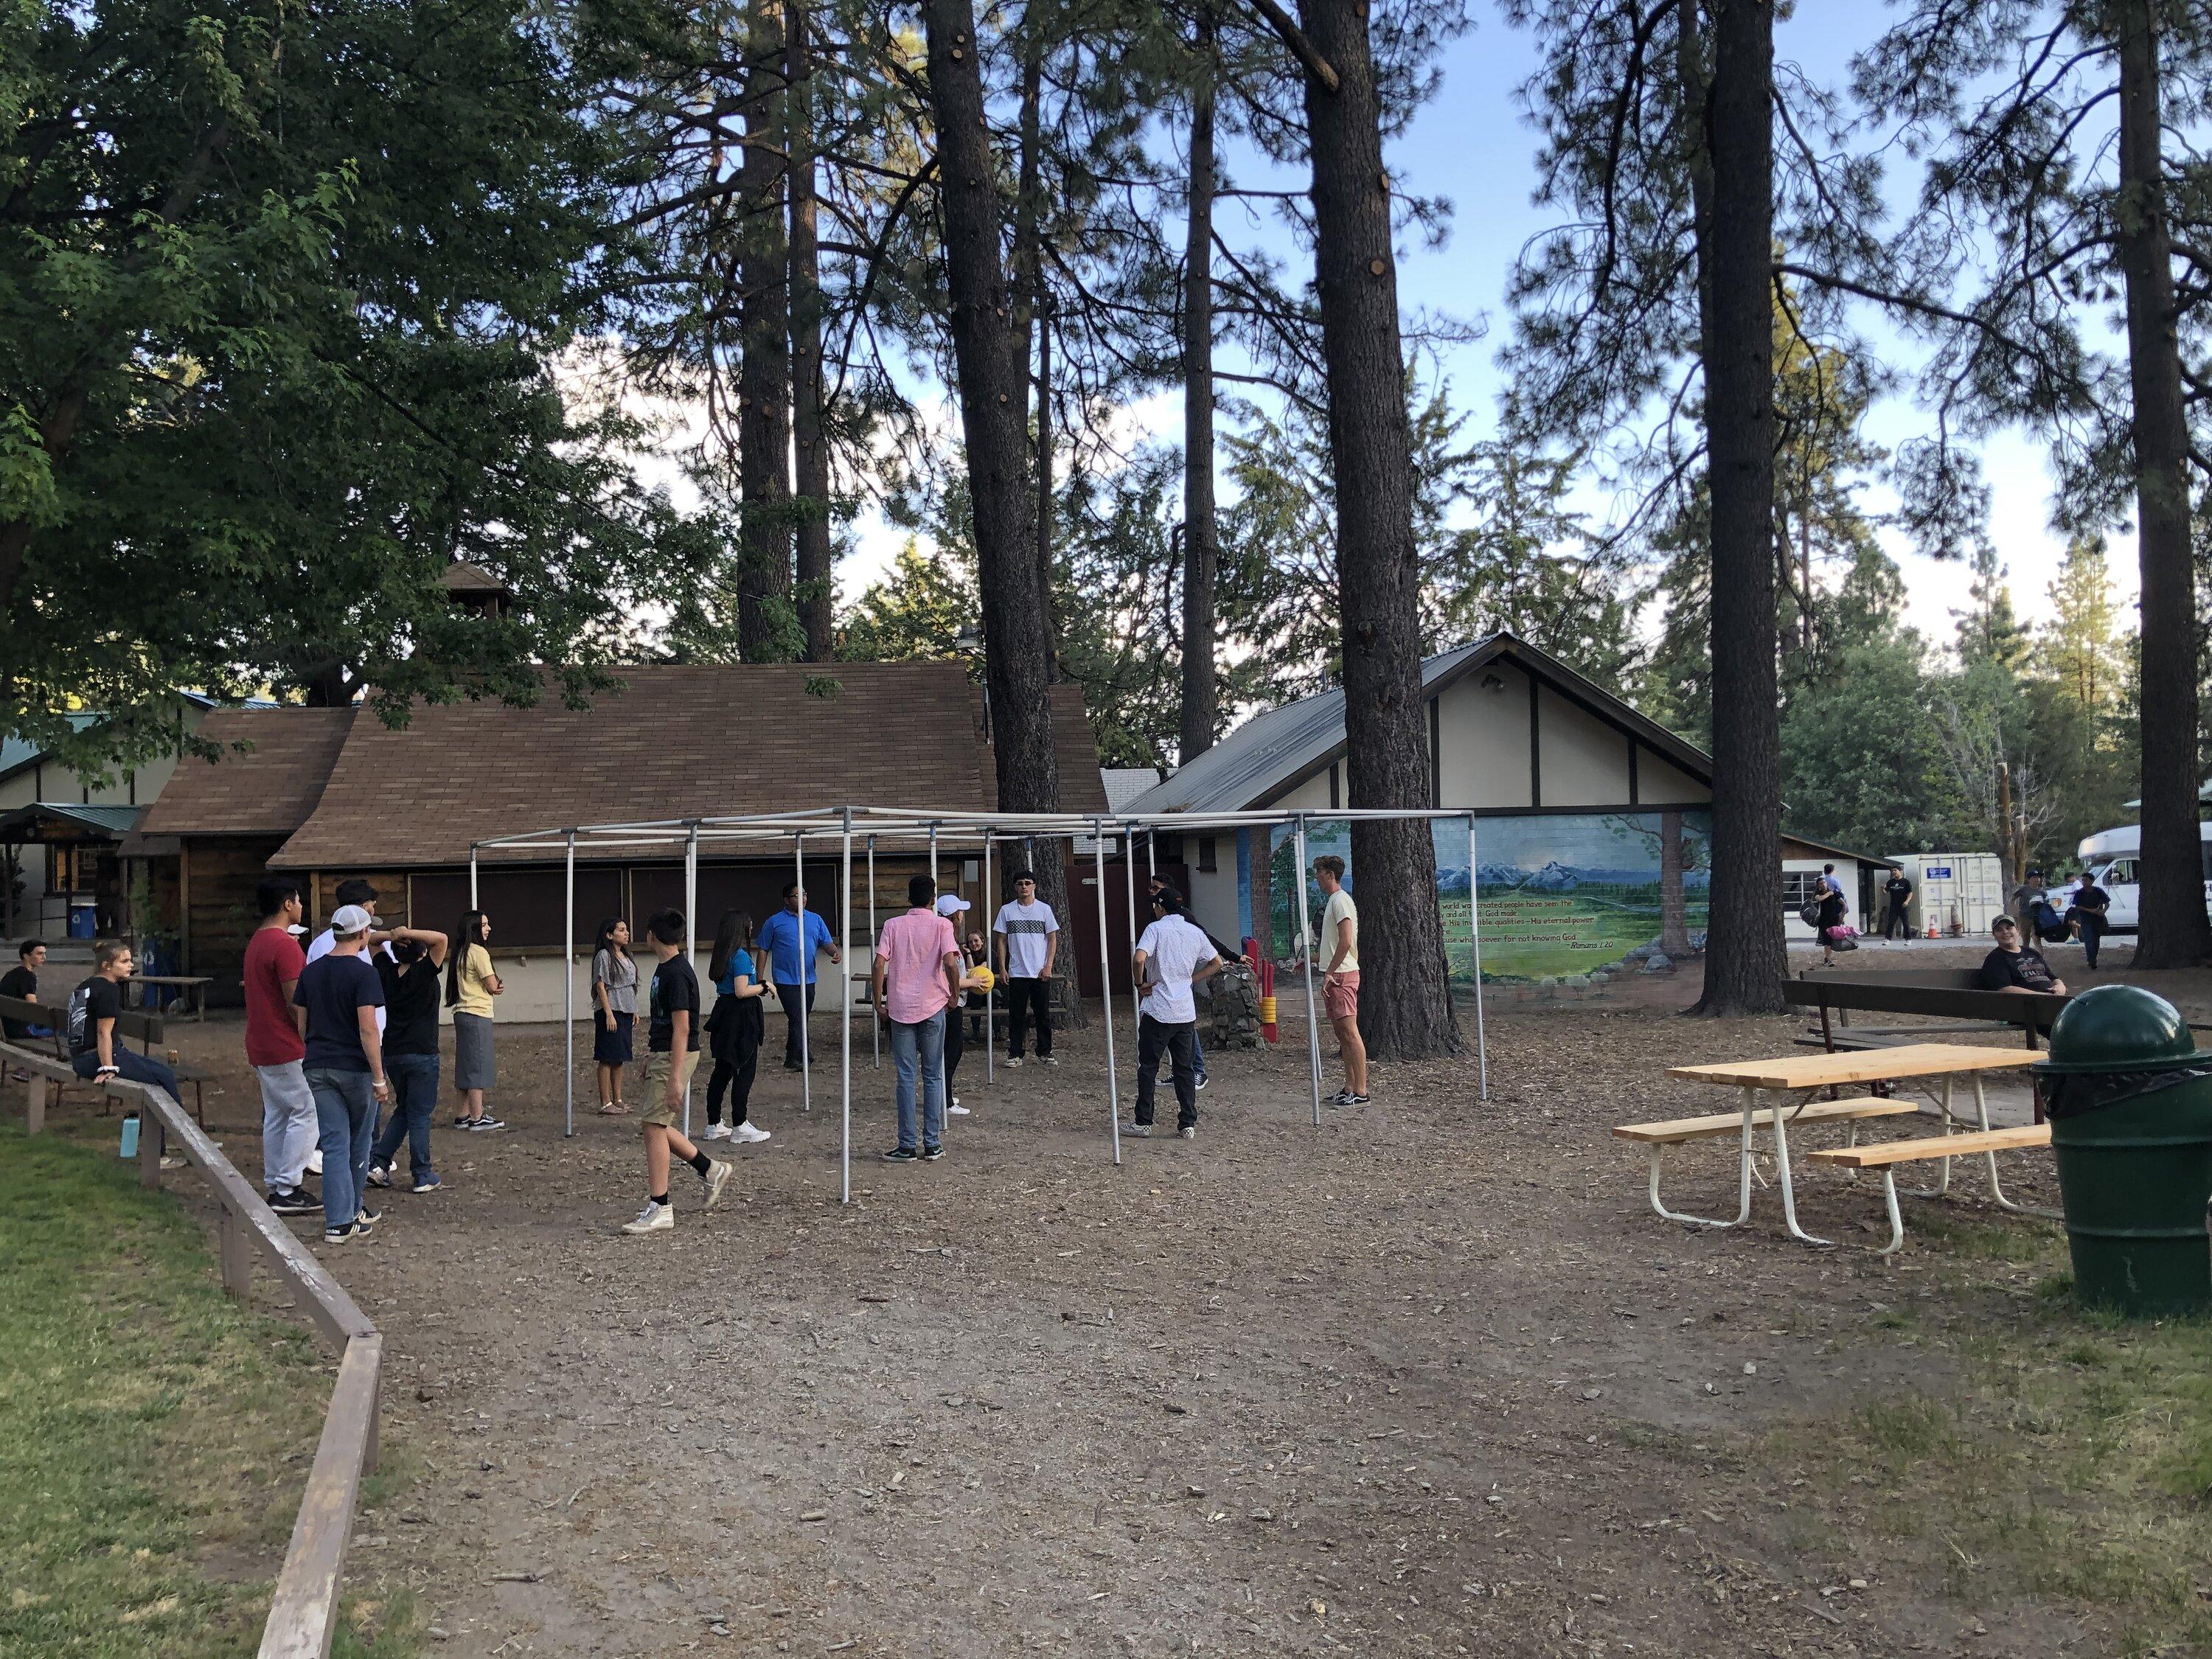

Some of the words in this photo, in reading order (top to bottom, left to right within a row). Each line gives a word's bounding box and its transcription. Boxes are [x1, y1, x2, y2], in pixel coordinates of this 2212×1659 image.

[1504, 901, 1524, 911] people
[1450, 919, 1461, 927] His
[1572, 917, 1594, 925] power
[1531, 934, 1561, 944] knowing
[1562, 933, 1576, 941] God
